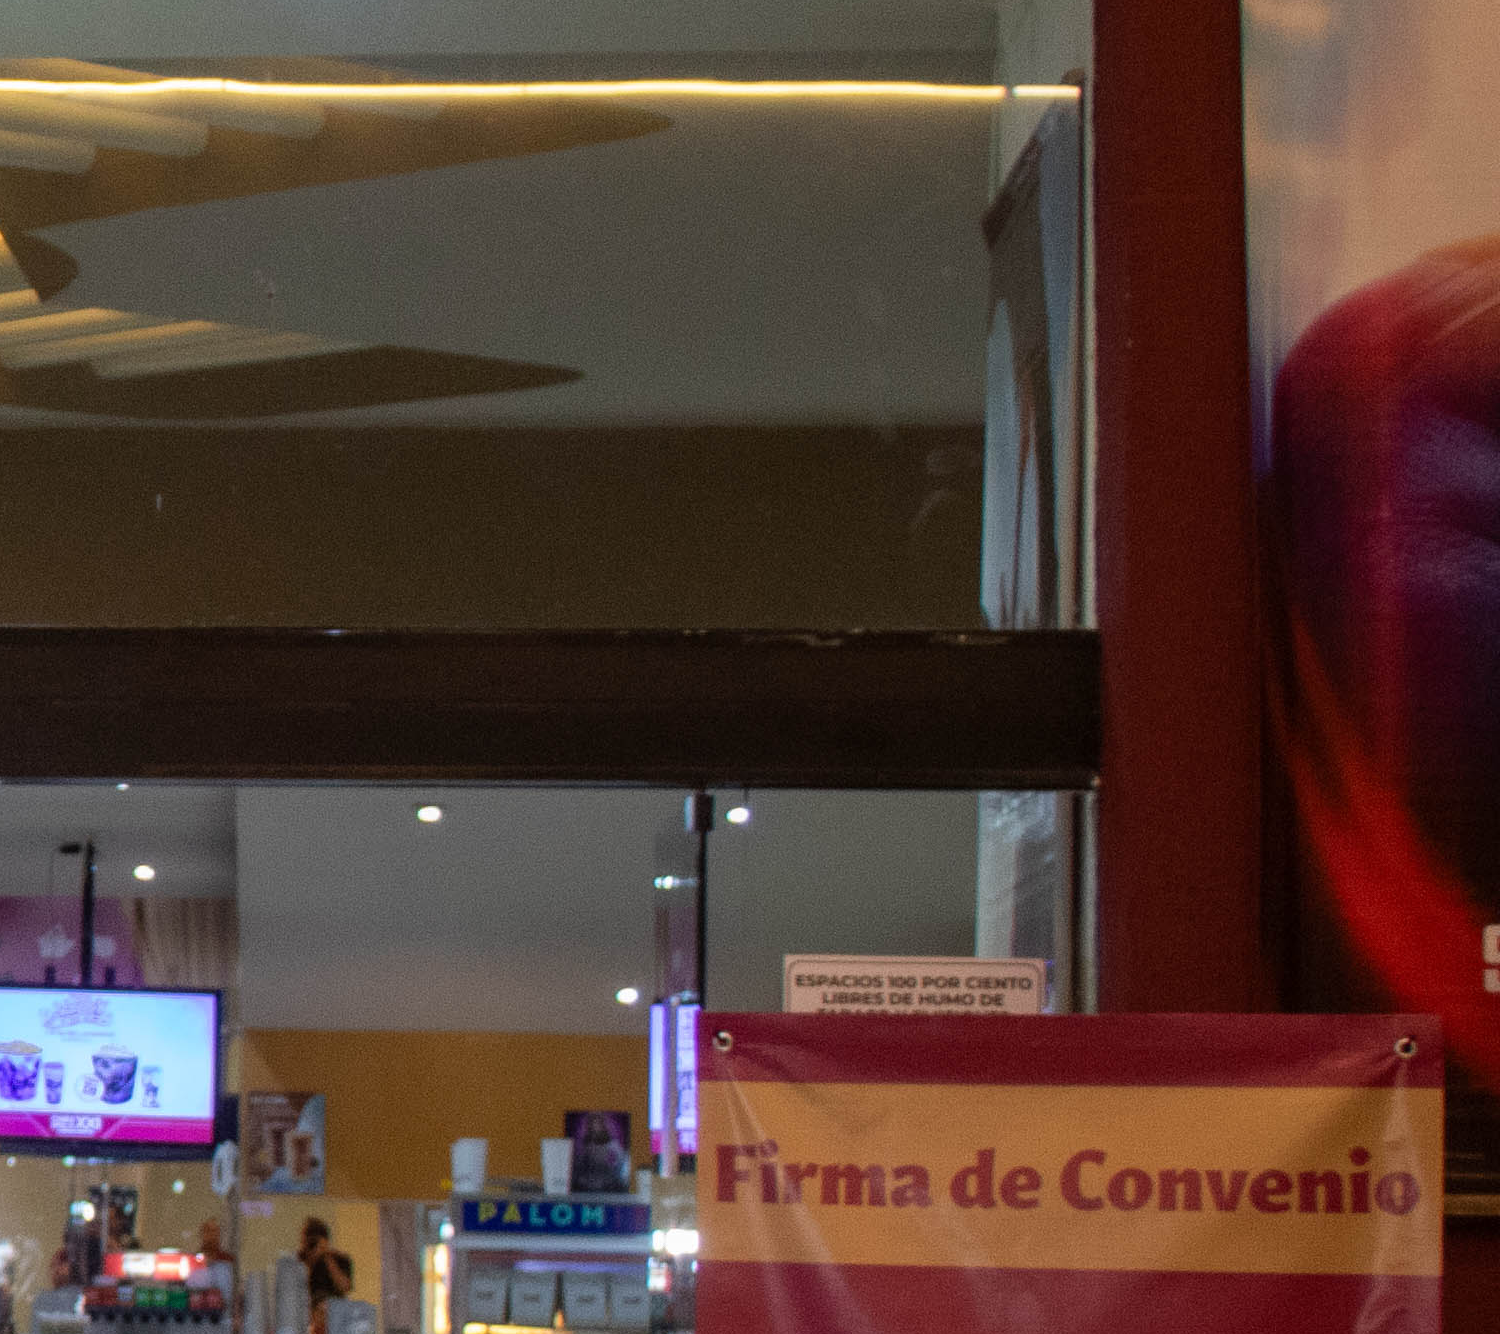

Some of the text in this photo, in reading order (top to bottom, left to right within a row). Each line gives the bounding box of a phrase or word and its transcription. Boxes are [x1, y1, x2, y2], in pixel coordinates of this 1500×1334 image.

[796, 974, 1032, 990] ESPACIOS 100 POR CIENTO
[822, 991, 1005, 1006] LIBRES DE HUMO DE
[715, 1139, 1422, 1217] Firma de Convenio
